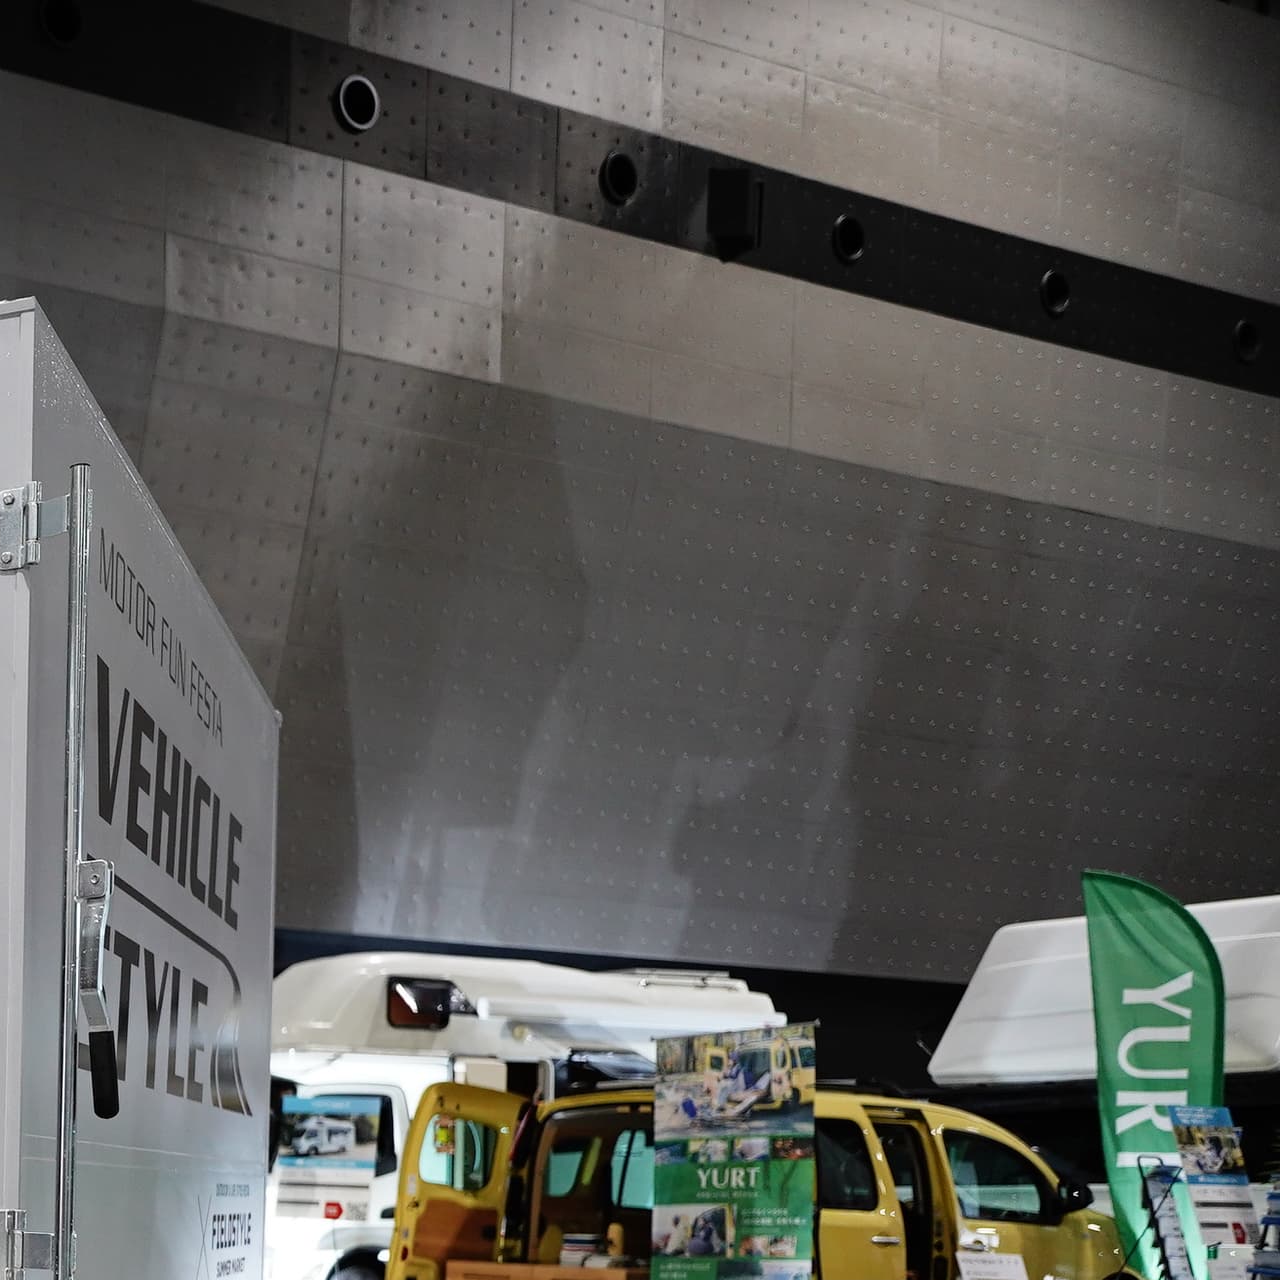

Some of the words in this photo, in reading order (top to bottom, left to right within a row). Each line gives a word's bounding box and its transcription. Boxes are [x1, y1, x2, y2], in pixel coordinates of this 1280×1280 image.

[99, 527, 156, 657] MOTOR
[160, 616, 187, 697] FUN
[189, 660, 224, 749] FESTA
[96, 653, 243, 932] VEHICLE
[211, 1211, 252, 1251] FIELDSTYLE
[696, 1166, 761, 1189] YURT
